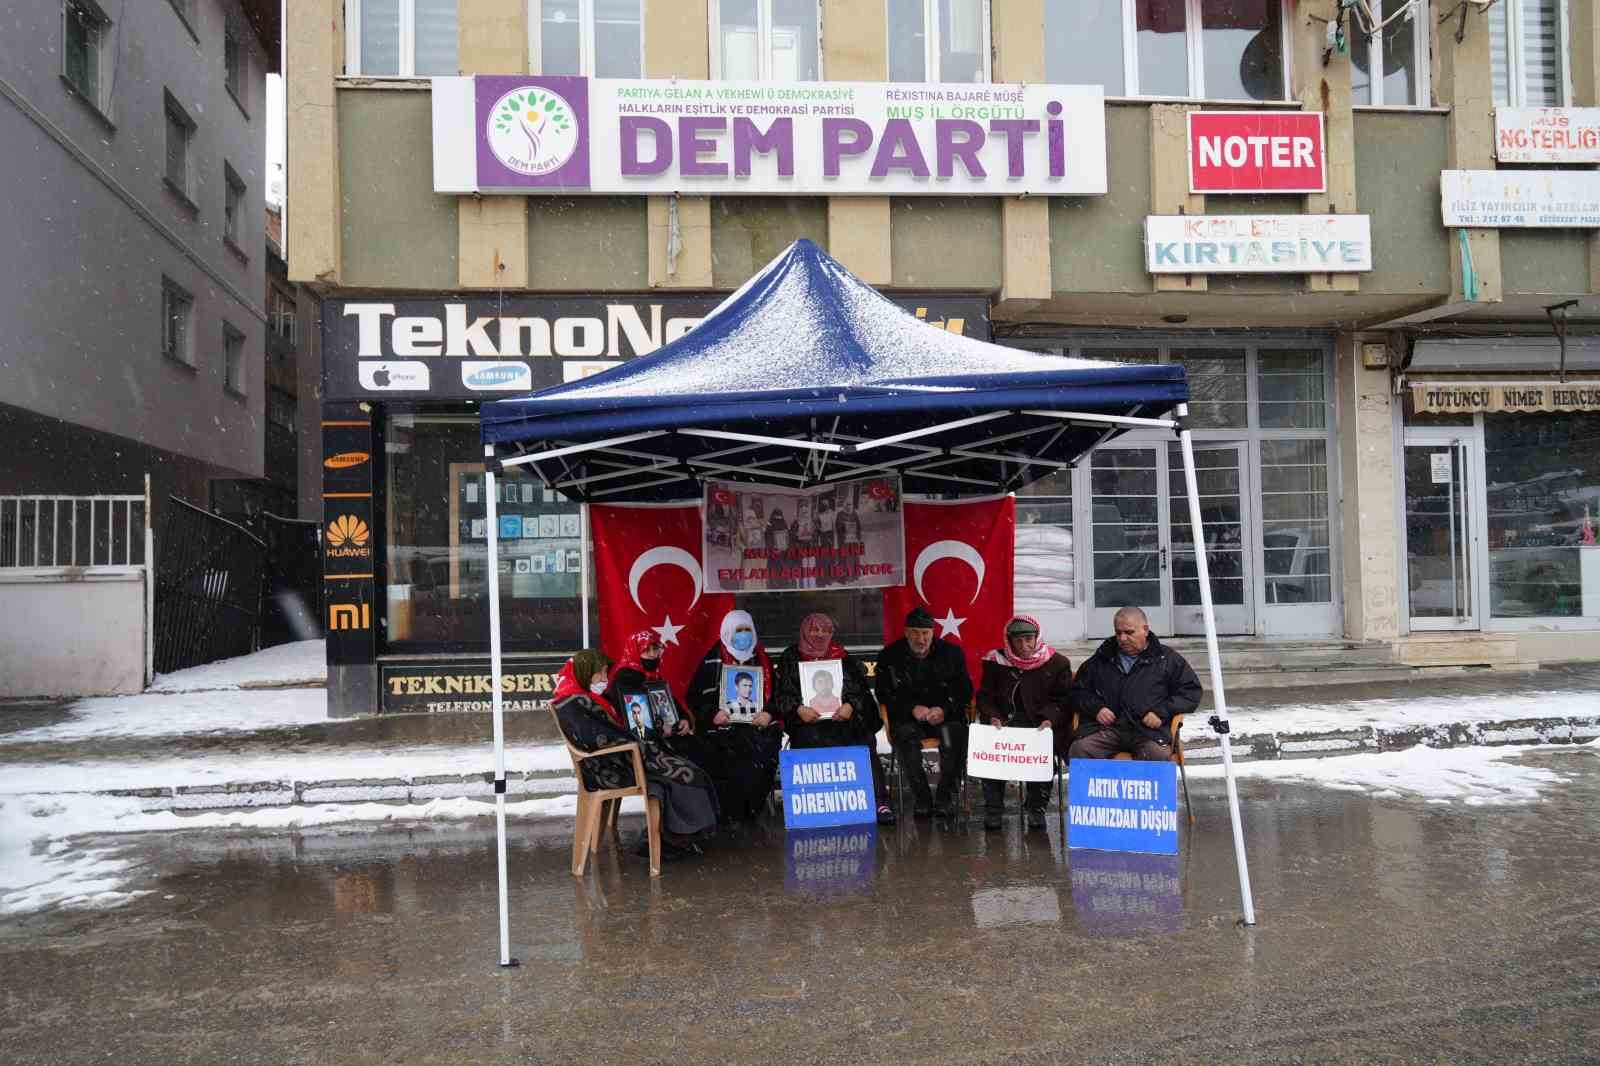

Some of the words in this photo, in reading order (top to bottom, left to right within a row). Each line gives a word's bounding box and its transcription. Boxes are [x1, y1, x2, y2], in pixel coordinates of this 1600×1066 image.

[618, 103, 682, 113] HALKLARIN
[685, 102, 727, 115] EŞİTLİK
[730, 104, 744, 114] VE
[746, 103, 808, 115] DEMOKRASİ
[813, 103, 855, 115] PARTİSİ
[930, 103, 945, 118] İL
[951, 103, 1025, 119] ÖRGÜTÜ
[619, 115, 794, 177] DEM
[821, 101, 1065, 178] PARTİ
[1199, 136, 1315, 167] NOTER
[1155, 239, 1363, 264] KIRTASİYE
[1426, 387, 1490, 407] TÜTÜNCÜ
[1503, 388, 1544, 407] NİMET
[327, 547, 370, 558] HUAWEI
[427, 701, 493, 713] TELEFON
[994, 742, 1026, 751] EVLAT
[972, 751, 1049, 764] NÖBETİNDEYİZ
[793, 760, 857, 785] ANNELER
[1087, 777, 1119, 800] ARTIK
[1120, 779, 1152, 800] YETER
[791, 785, 868, 815] DİRENİYOR
[1069, 804, 1138, 829] YAKAMIZDAN
[1140, 805, 1177, 836] DÜŞÜN
